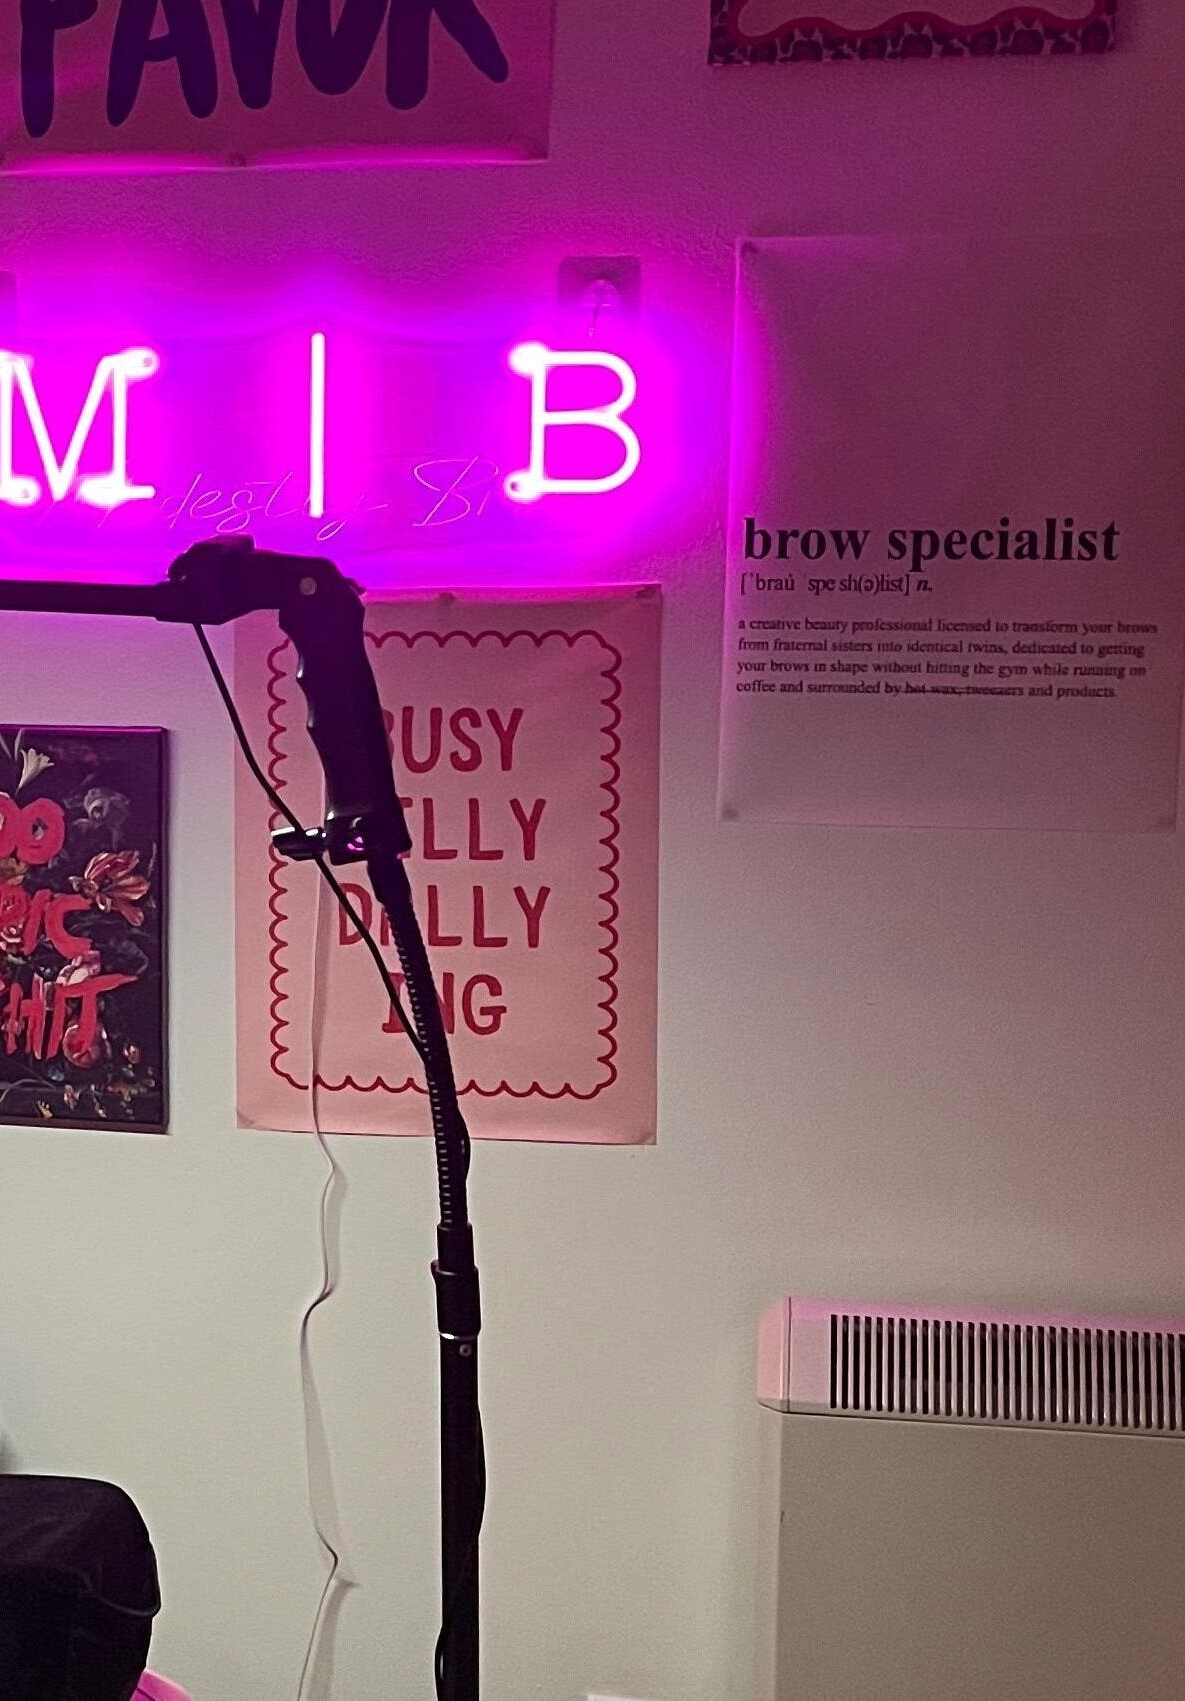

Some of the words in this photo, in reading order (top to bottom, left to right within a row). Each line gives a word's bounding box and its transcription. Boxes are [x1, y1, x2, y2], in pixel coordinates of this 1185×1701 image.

[505, 340, 642, 504] B
[742, 516, 872, 561] brow
[887, 515, 1120, 573] specialist
[916, 579, 933, 592] n.
[738, 619, 746, 630] a
[749, 618, 801, 630] creative
[804, 616, 848, 633] beauty
[852, 617, 932, 635] professional
[937, 618, 991, 632] licensed
[996, 619, 1008, 632] to
[1012, 619, 1077, 632] transform
[1081, 622, 1112, 636] your
[1117, 620, 1158, 633] brows
[738, 637, 768, 651] from
[774, 637, 827, 651] fraternal
[832, 640, 872, 652] sisters
[877, 641, 902, 653] into
[907, 639, 963, 653] identical
[968, 641, 1007, 656] twins,
[1012, 640, 1076, 654] dedicated
[1081, 643, 1094, 654] to
[1098, 643, 1145, 658] getting
[736, 661, 767, 675] your
[770, 659, 810, 672] brows
[814, 661, 827, 672] in
[830, 659, 868, 676] shape
[872, 660, 921, 673] without
[926, 660, 969, 677] hitting
[975, 662, 993, 674] the
[998, 664, 1027, 678] gym
[1032, 662, 1069, 676] while
[1073, 664, 1125, 679] running
[1129, 666, 1146, 677] on
[735, 679, 776, 693] coffee
[779, 679, 804, 693] and
[807, 680, 880, 694] surrounded
[884, 682, 901, 697] by
[1028, 684, 1054, 697] and
[381, 706, 524, 774] USY
[338, 882, 551, 949] DLLY
